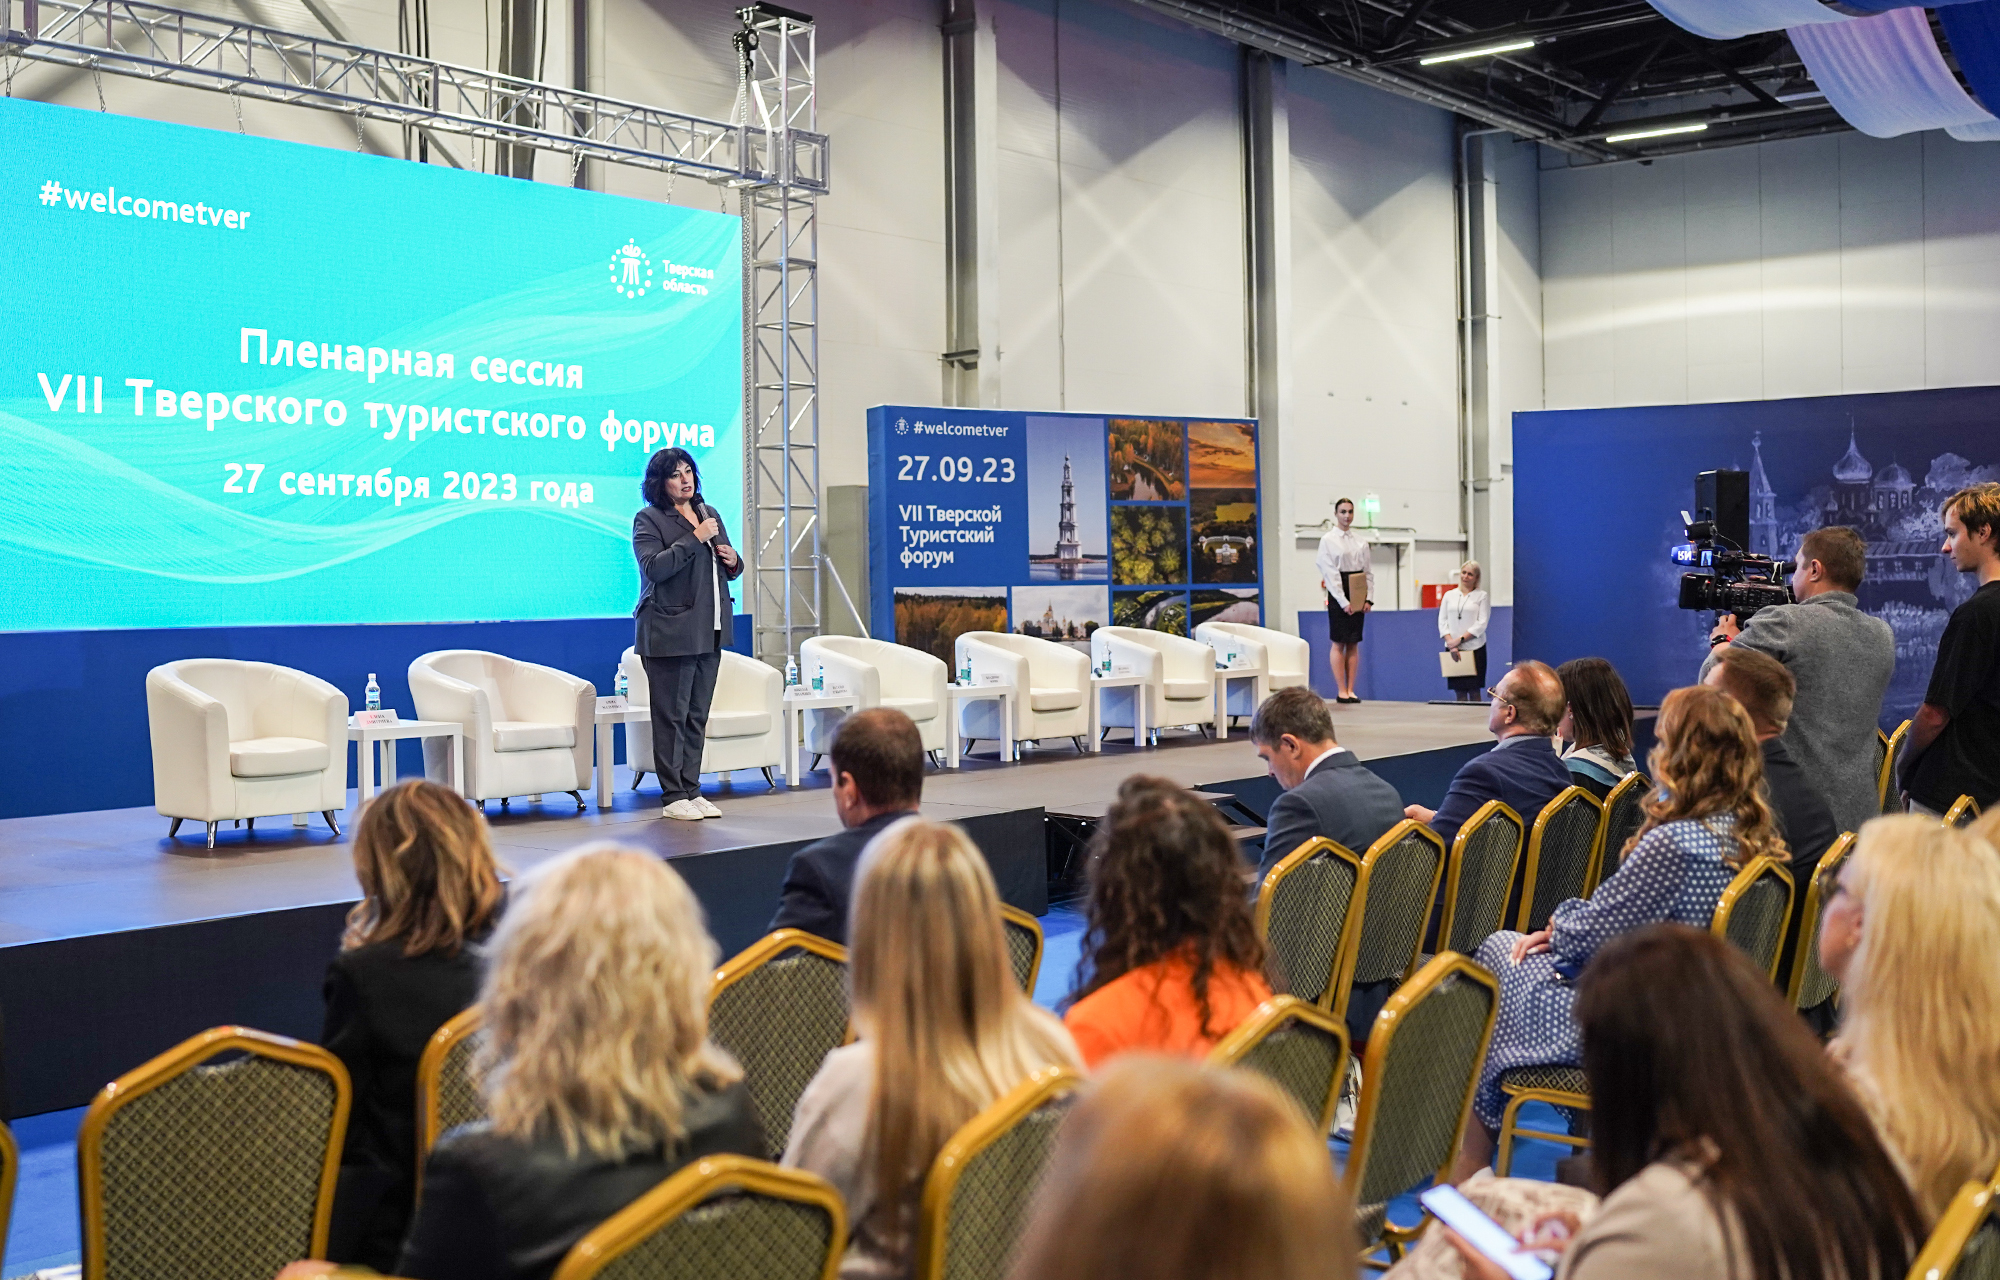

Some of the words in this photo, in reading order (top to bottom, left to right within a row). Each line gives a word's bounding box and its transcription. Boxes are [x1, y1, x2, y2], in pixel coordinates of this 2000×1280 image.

[39, 180, 250, 229] #welcometver
[662, 259, 714, 279] Тверская
[662, 278, 709, 296] область
[241, 328, 454, 383] Пленарная
[471, 356, 582, 389] сессия
[38, 373, 102, 413] VII
[126, 379, 347, 431] Тверского
[364, 402, 586, 441] туристского
[600, 410, 714, 453] форума
[914, 421, 1008, 436] #welcometver
[898, 455, 1015, 482] 27.09.23
[224, 463, 265, 493] 27
[280, 468, 429, 506] сентября
[443, 471, 517, 501] 2023
[531, 481, 593, 508] года
[899, 505, 922, 521] VII
[926, 505, 1002, 527] Тверской
[899, 526, 995, 548] Туристский
[900, 546, 954, 569] форум
